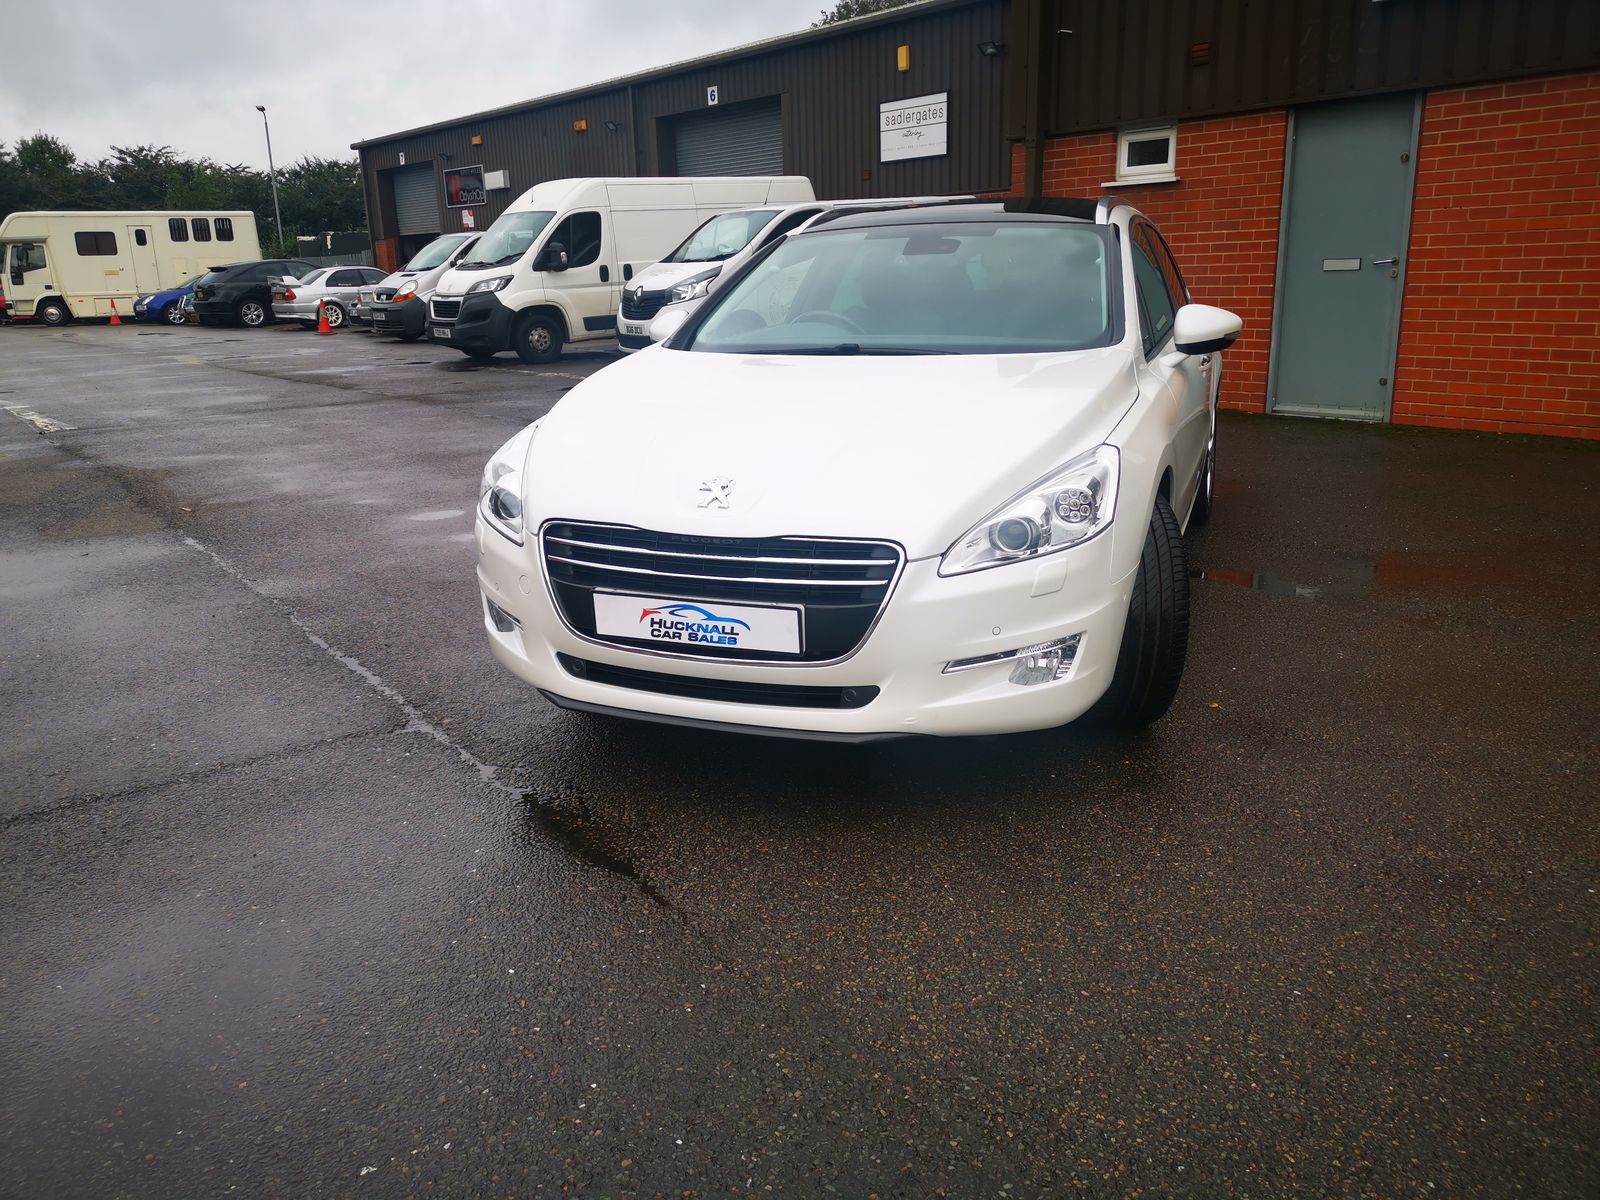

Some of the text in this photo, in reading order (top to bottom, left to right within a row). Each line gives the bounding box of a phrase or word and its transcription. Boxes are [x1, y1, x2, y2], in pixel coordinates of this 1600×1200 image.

[709, 89, 716, 102] 6
[885, 107, 943, 126] sadlergates
[650, 618, 740, 635] HUCKNALL
[651, 629, 738, 645] CAR SALES
